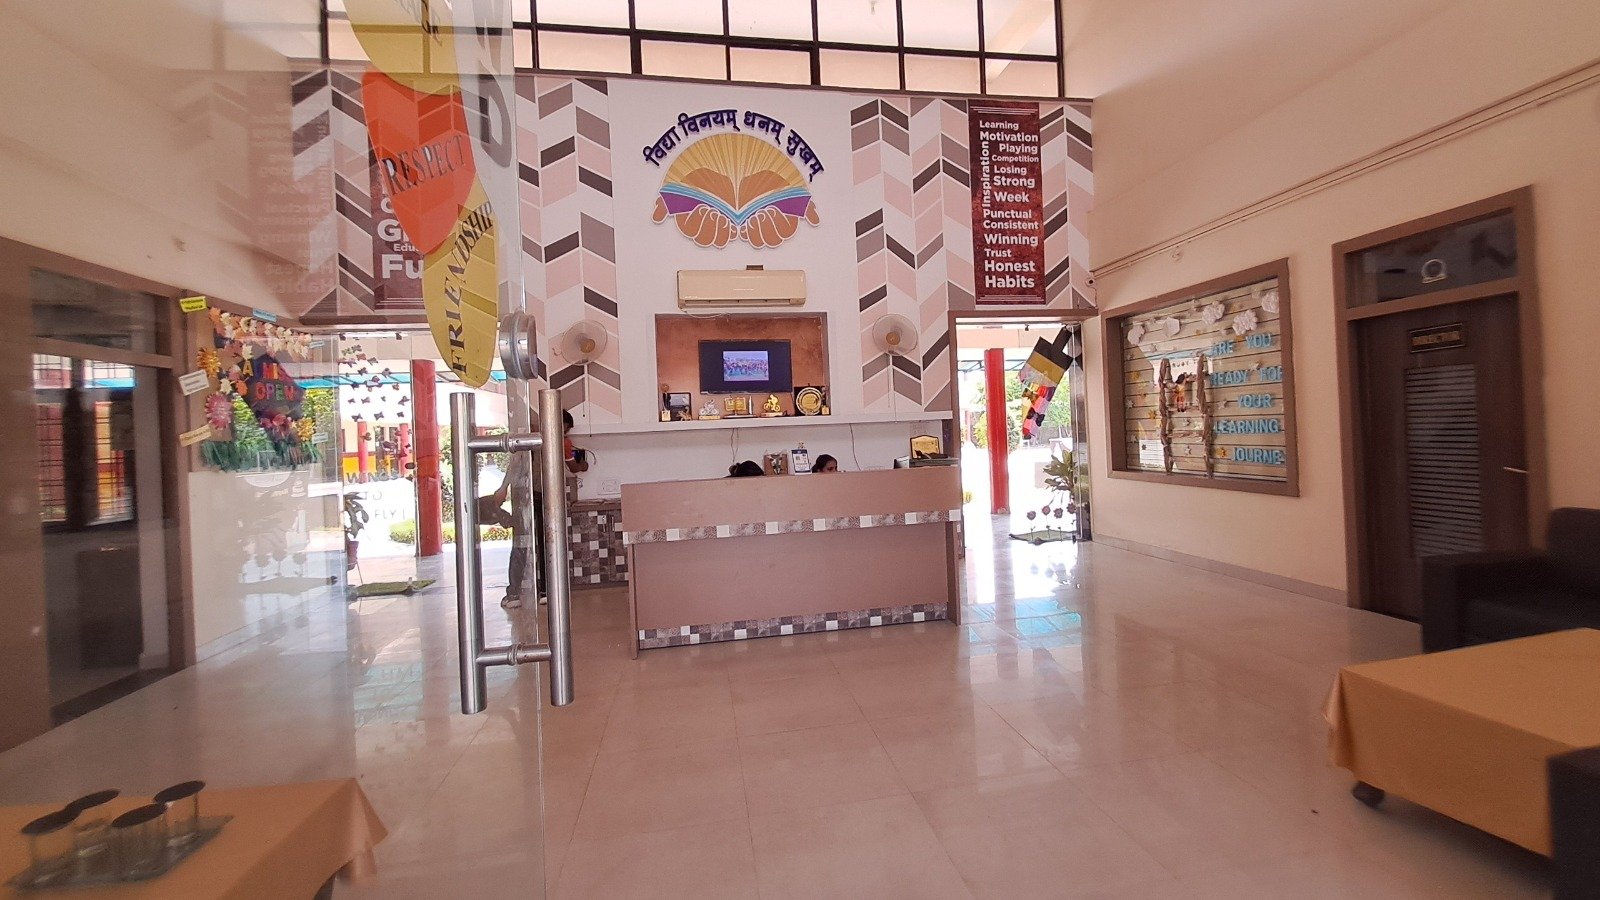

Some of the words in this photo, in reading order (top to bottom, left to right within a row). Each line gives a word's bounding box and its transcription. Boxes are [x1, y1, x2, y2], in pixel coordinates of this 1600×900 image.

[979, 120, 1019, 130] Learning
[980, 131, 1039, 142] Motivation
[643, 125, 681, 166] विद्या
[678, 109, 740, 136] विनयम्
[744, 110, 785, 145] धनम्
[787, 128, 824, 182] सुखम्
[999, 143, 1038, 154] Playing
[380, 134, 466, 195] RESPECT
[991, 154, 1039, 163] Competition
[980, 141, 992, 207] Inspiration
[993, 165, 1027, 175] Losing
[993, 175, 1035, 188] Strong
[993, 191, 1029, 203] Week
[983, 208, 1032, 219] Punctual
[983, 219, 1039, 230] Consistent
[983, 233, 1039, 247] Winning
[984, 248, 1012, 257] Trust
[984, 259, 1036, 272] Honest
[444, 200, 493, 374] FRIENDSHIP
[985, 275, 1035, 288] Habits
[1245, 334, 1272, 349] YOU
[1214, 418, 1280, 434] LEARNING
